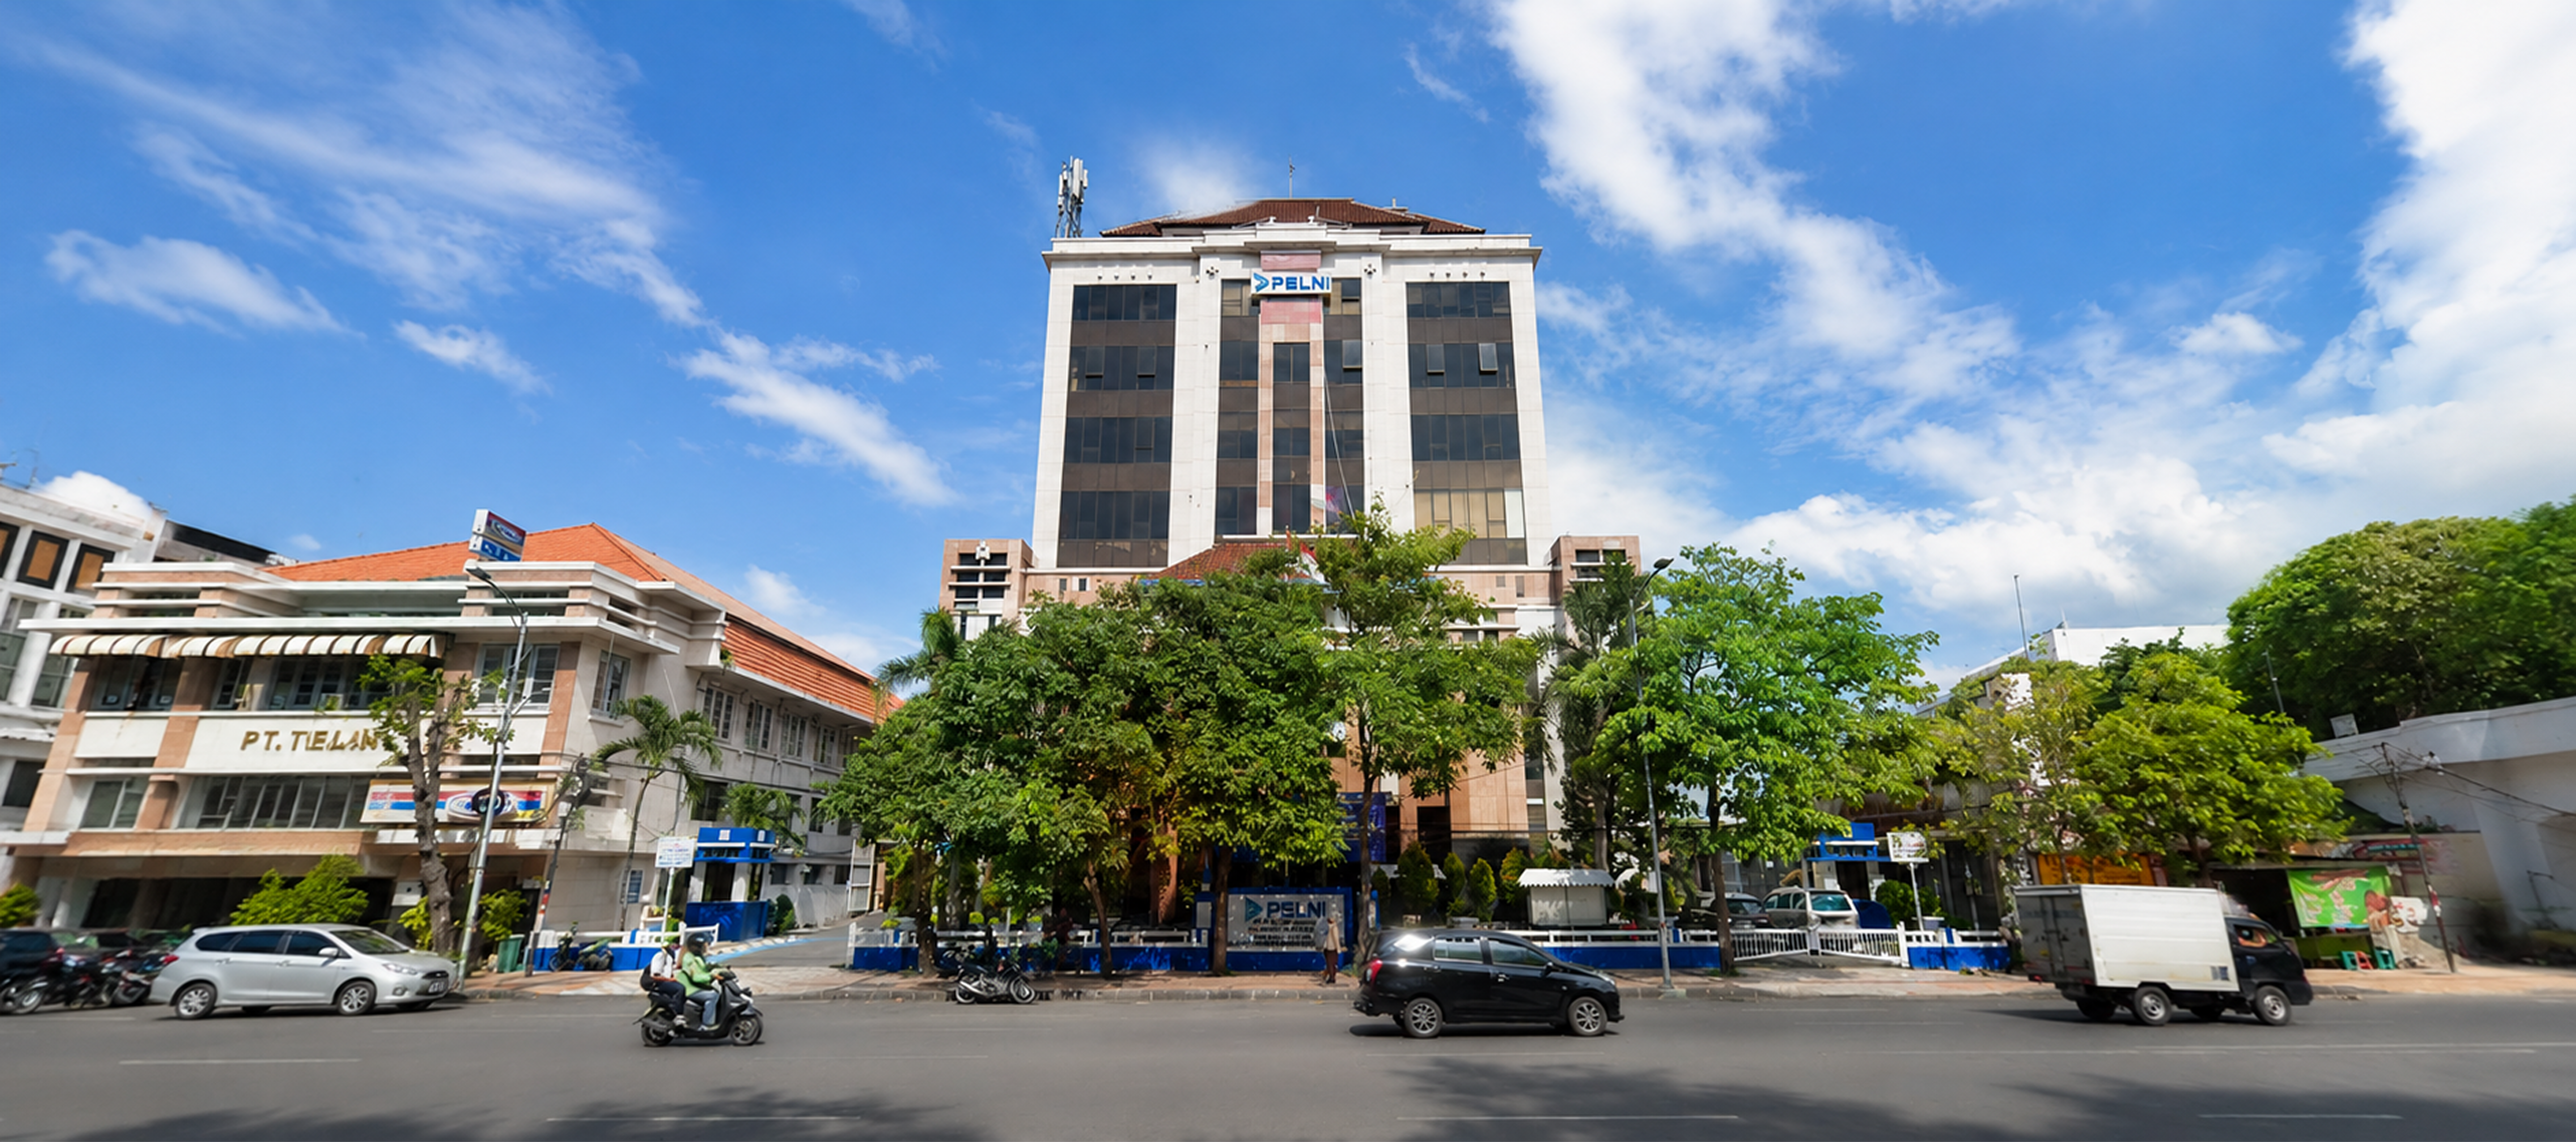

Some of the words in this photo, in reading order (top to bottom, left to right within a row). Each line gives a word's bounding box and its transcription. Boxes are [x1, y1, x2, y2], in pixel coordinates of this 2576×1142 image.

[1272, 276, 1330, 290] PELNI
[240, 731, 282, 751] PT.
[1267, 901, 1326, 918] PELNI
